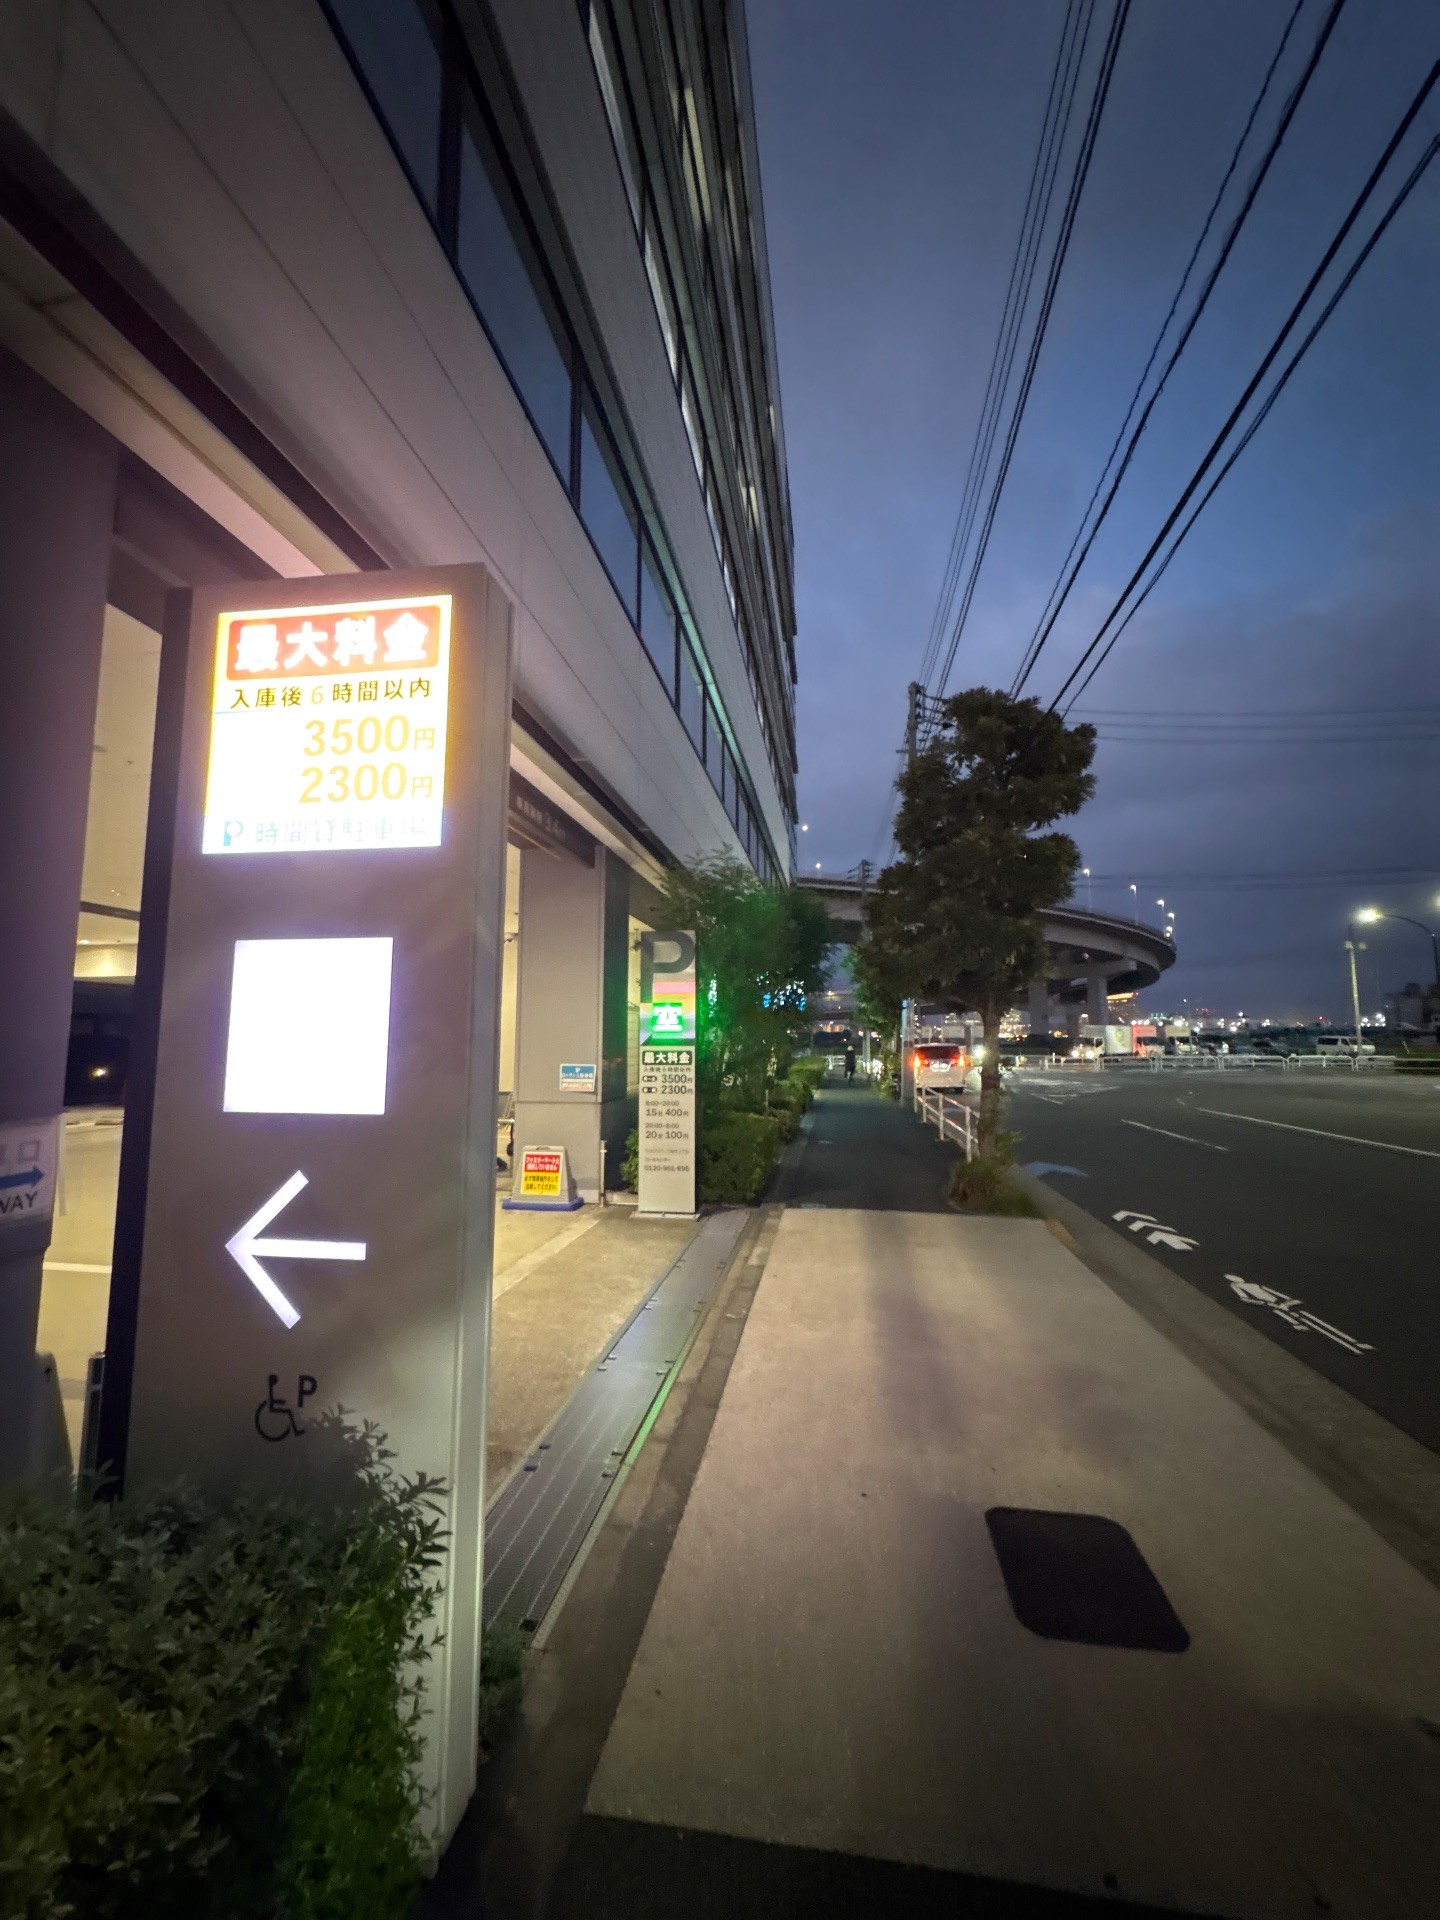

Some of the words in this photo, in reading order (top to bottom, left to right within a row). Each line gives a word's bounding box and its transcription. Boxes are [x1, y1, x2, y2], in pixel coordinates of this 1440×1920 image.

[234, 613, 430, 672] 最大料金
[230, 677, 432, 709] 入庫後6時間以内
[303, 714, 437, 757] 3500円
[298, 762, 434, 804] 2300円
[643, 1051, 691, 1064] 最大料金
